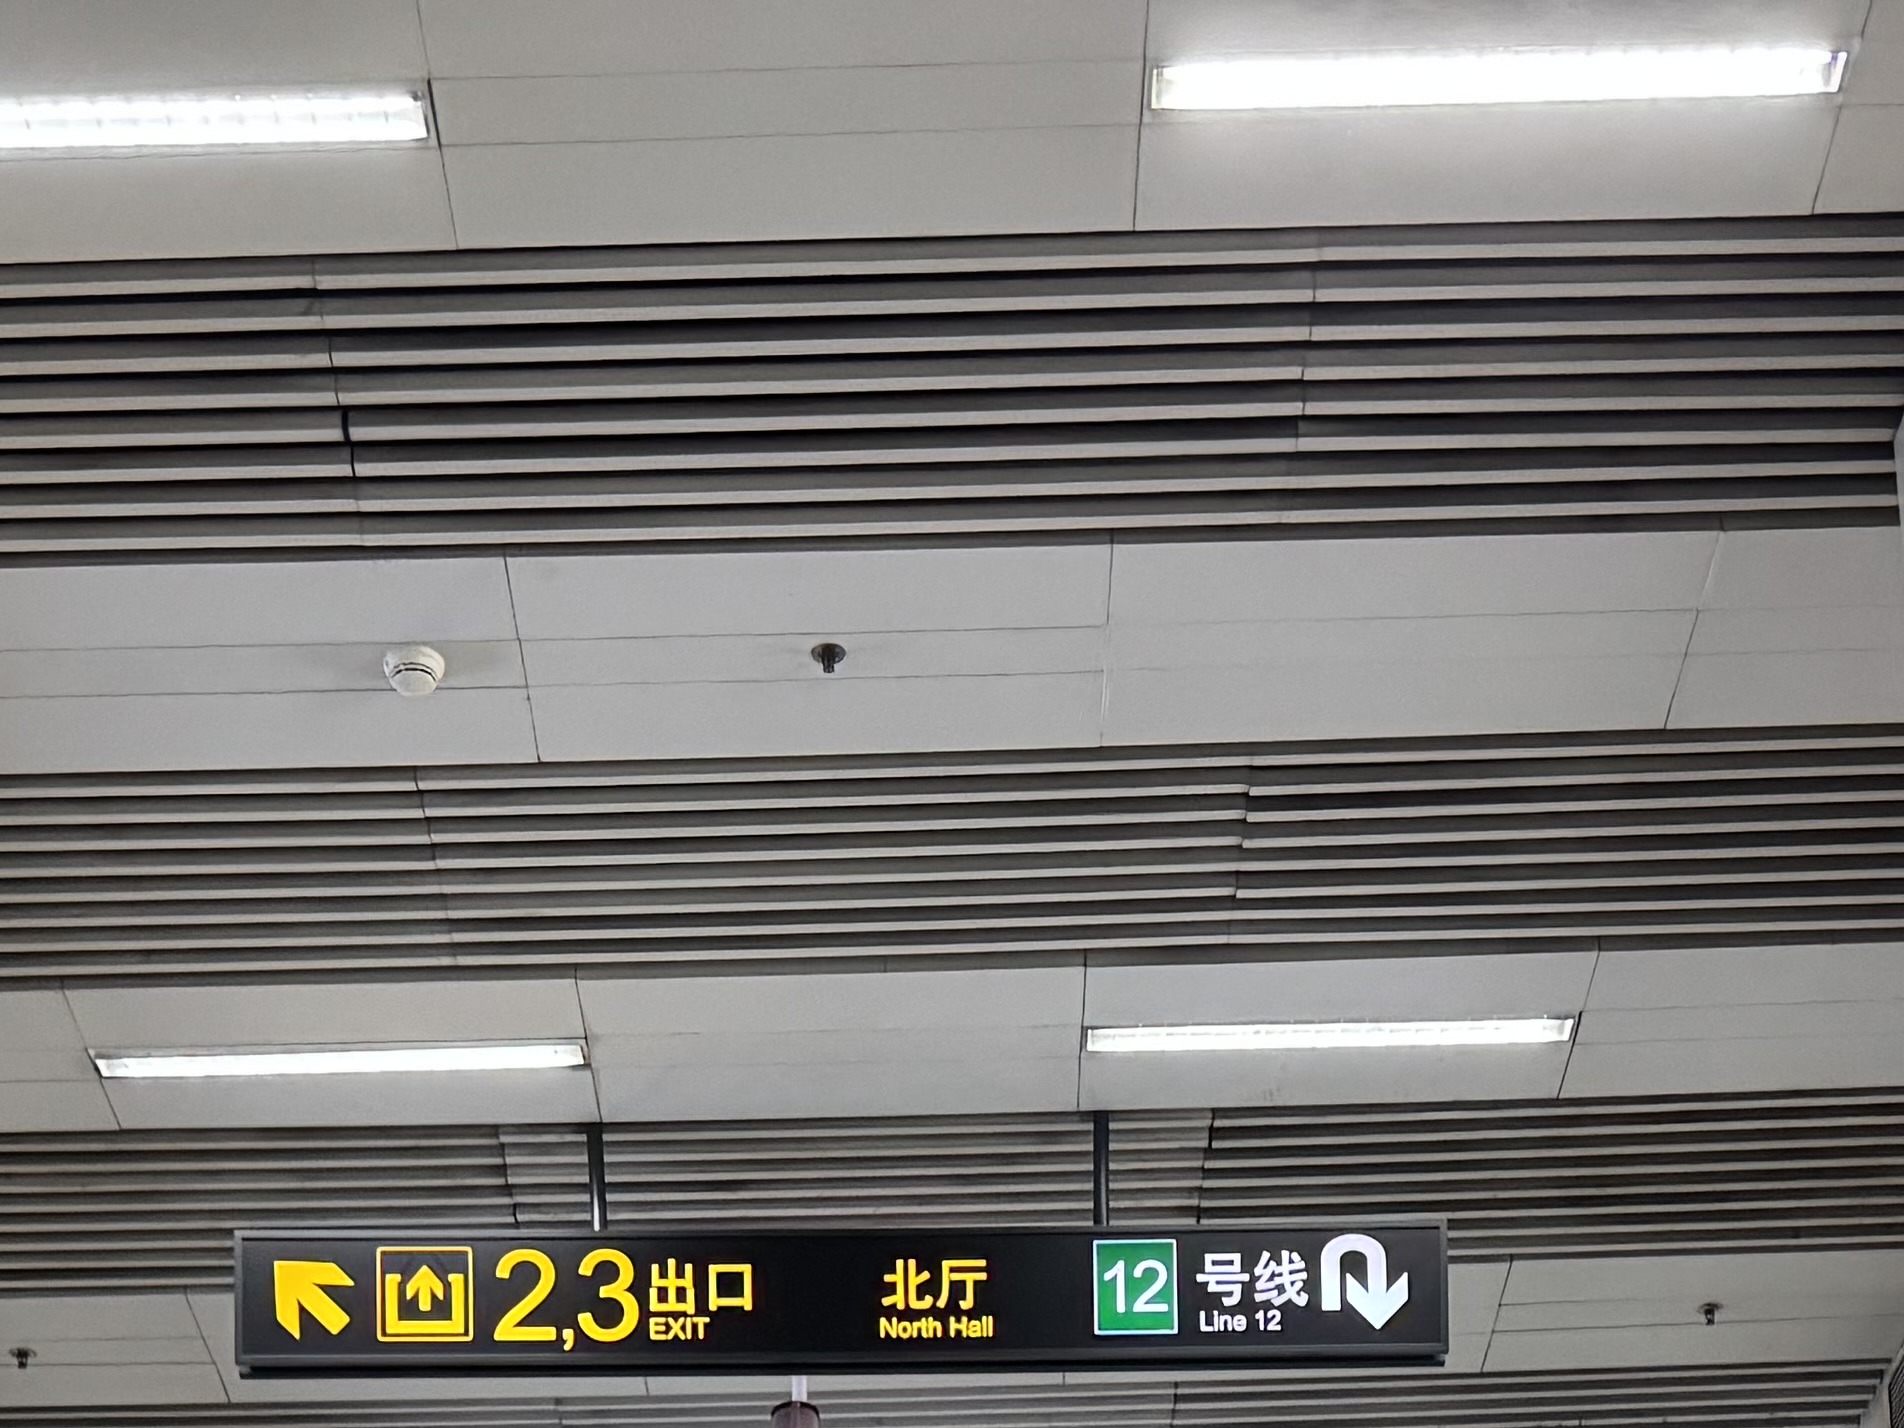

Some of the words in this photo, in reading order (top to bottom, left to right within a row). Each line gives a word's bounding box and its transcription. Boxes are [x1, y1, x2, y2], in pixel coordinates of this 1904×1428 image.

[493, 1248, 640, 1352] 2,3
[649, 1258, 753, 1314] 出口
[882, 1258, 988, 1311] 北厅
[1103, 1259, 1169, 1314] 12
[1195, 1250, 1309, 1307] 号线
[649, 1317, 710, 1341] EXIT
[879, 1316, 943, 1339] North
[949, 1315, 994, 1338] Hall
[1199, 1310, 1247, 1332] Line
[1254, 1309, 1282, 1331] 12
